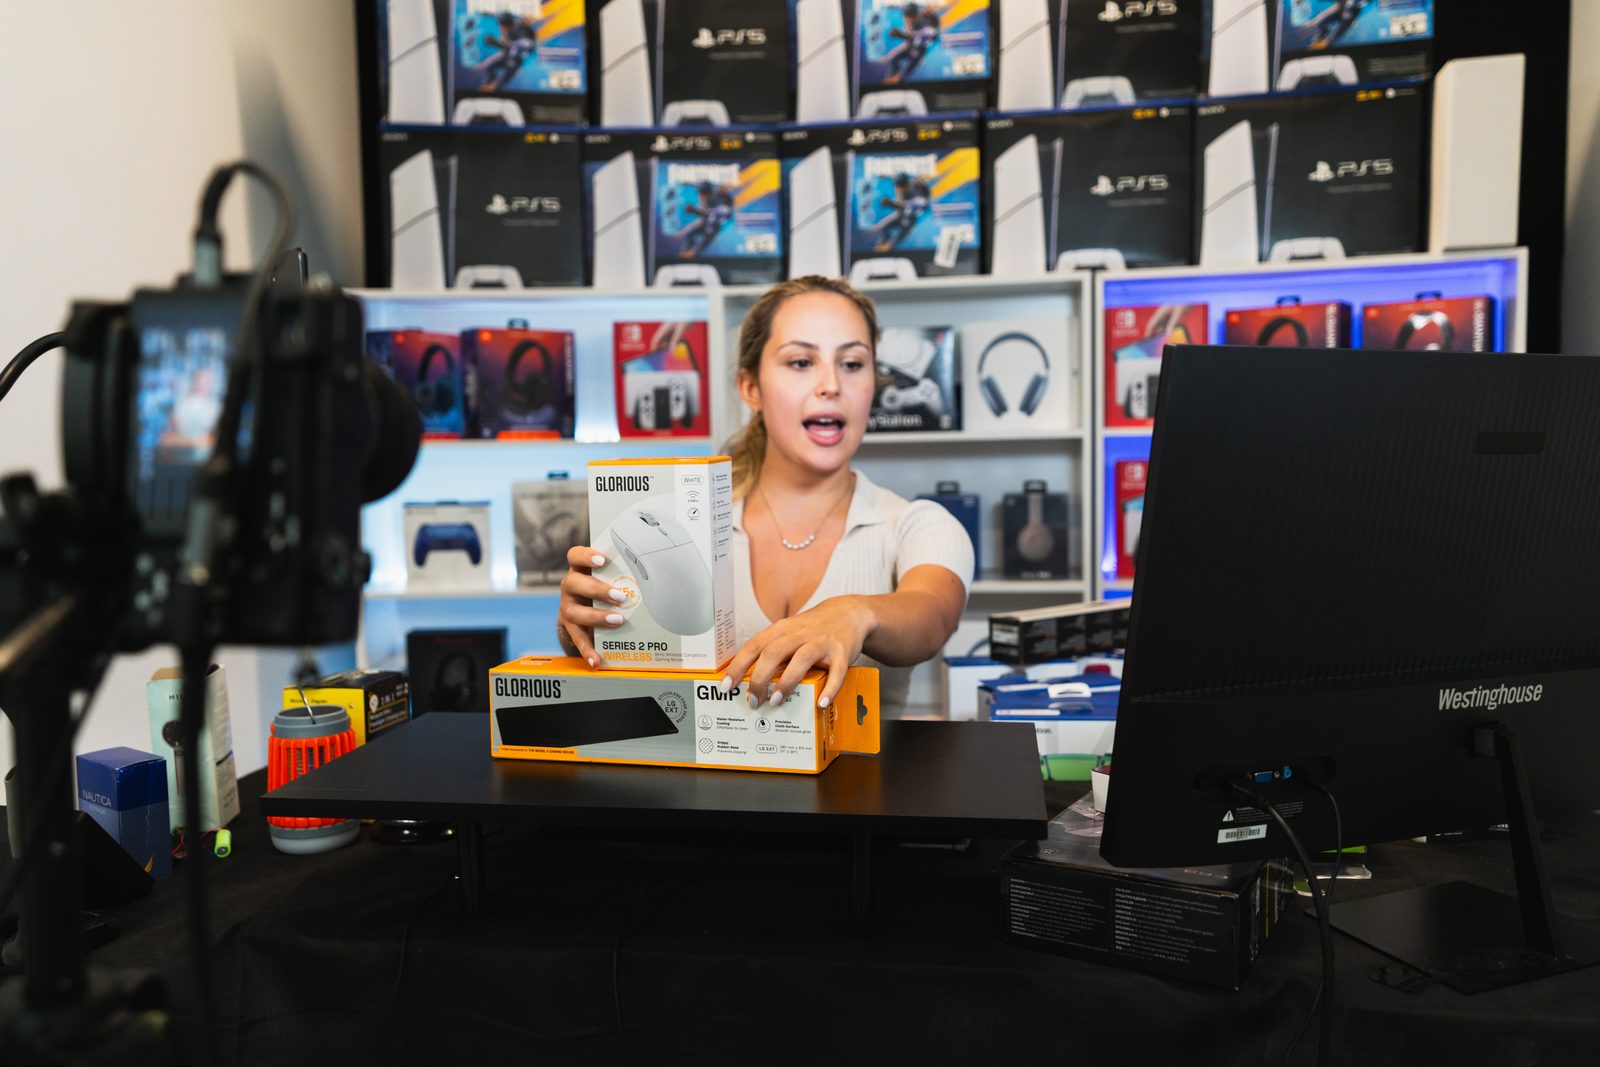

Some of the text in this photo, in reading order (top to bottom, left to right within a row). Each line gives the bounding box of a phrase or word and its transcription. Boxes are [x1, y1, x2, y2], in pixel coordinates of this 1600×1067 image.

[716, 28, 766, 45] PS5
[1337, 158, 1394, 177] PS5
[1116, 174, 1169, 192] PS5
[511, 196, 562, 213] PS5
[596, 476, 649, 492] GLORIOUS
[602, 641, 668, 651] SERIES 2 PRO
[602, 651, 653, 662] WIRELESS
[495, 677, 561, 698] GLORIOUS
[1438, 683, 1543, 711] Westinghouse
[83, 789, 112, 808] NAUTICA
